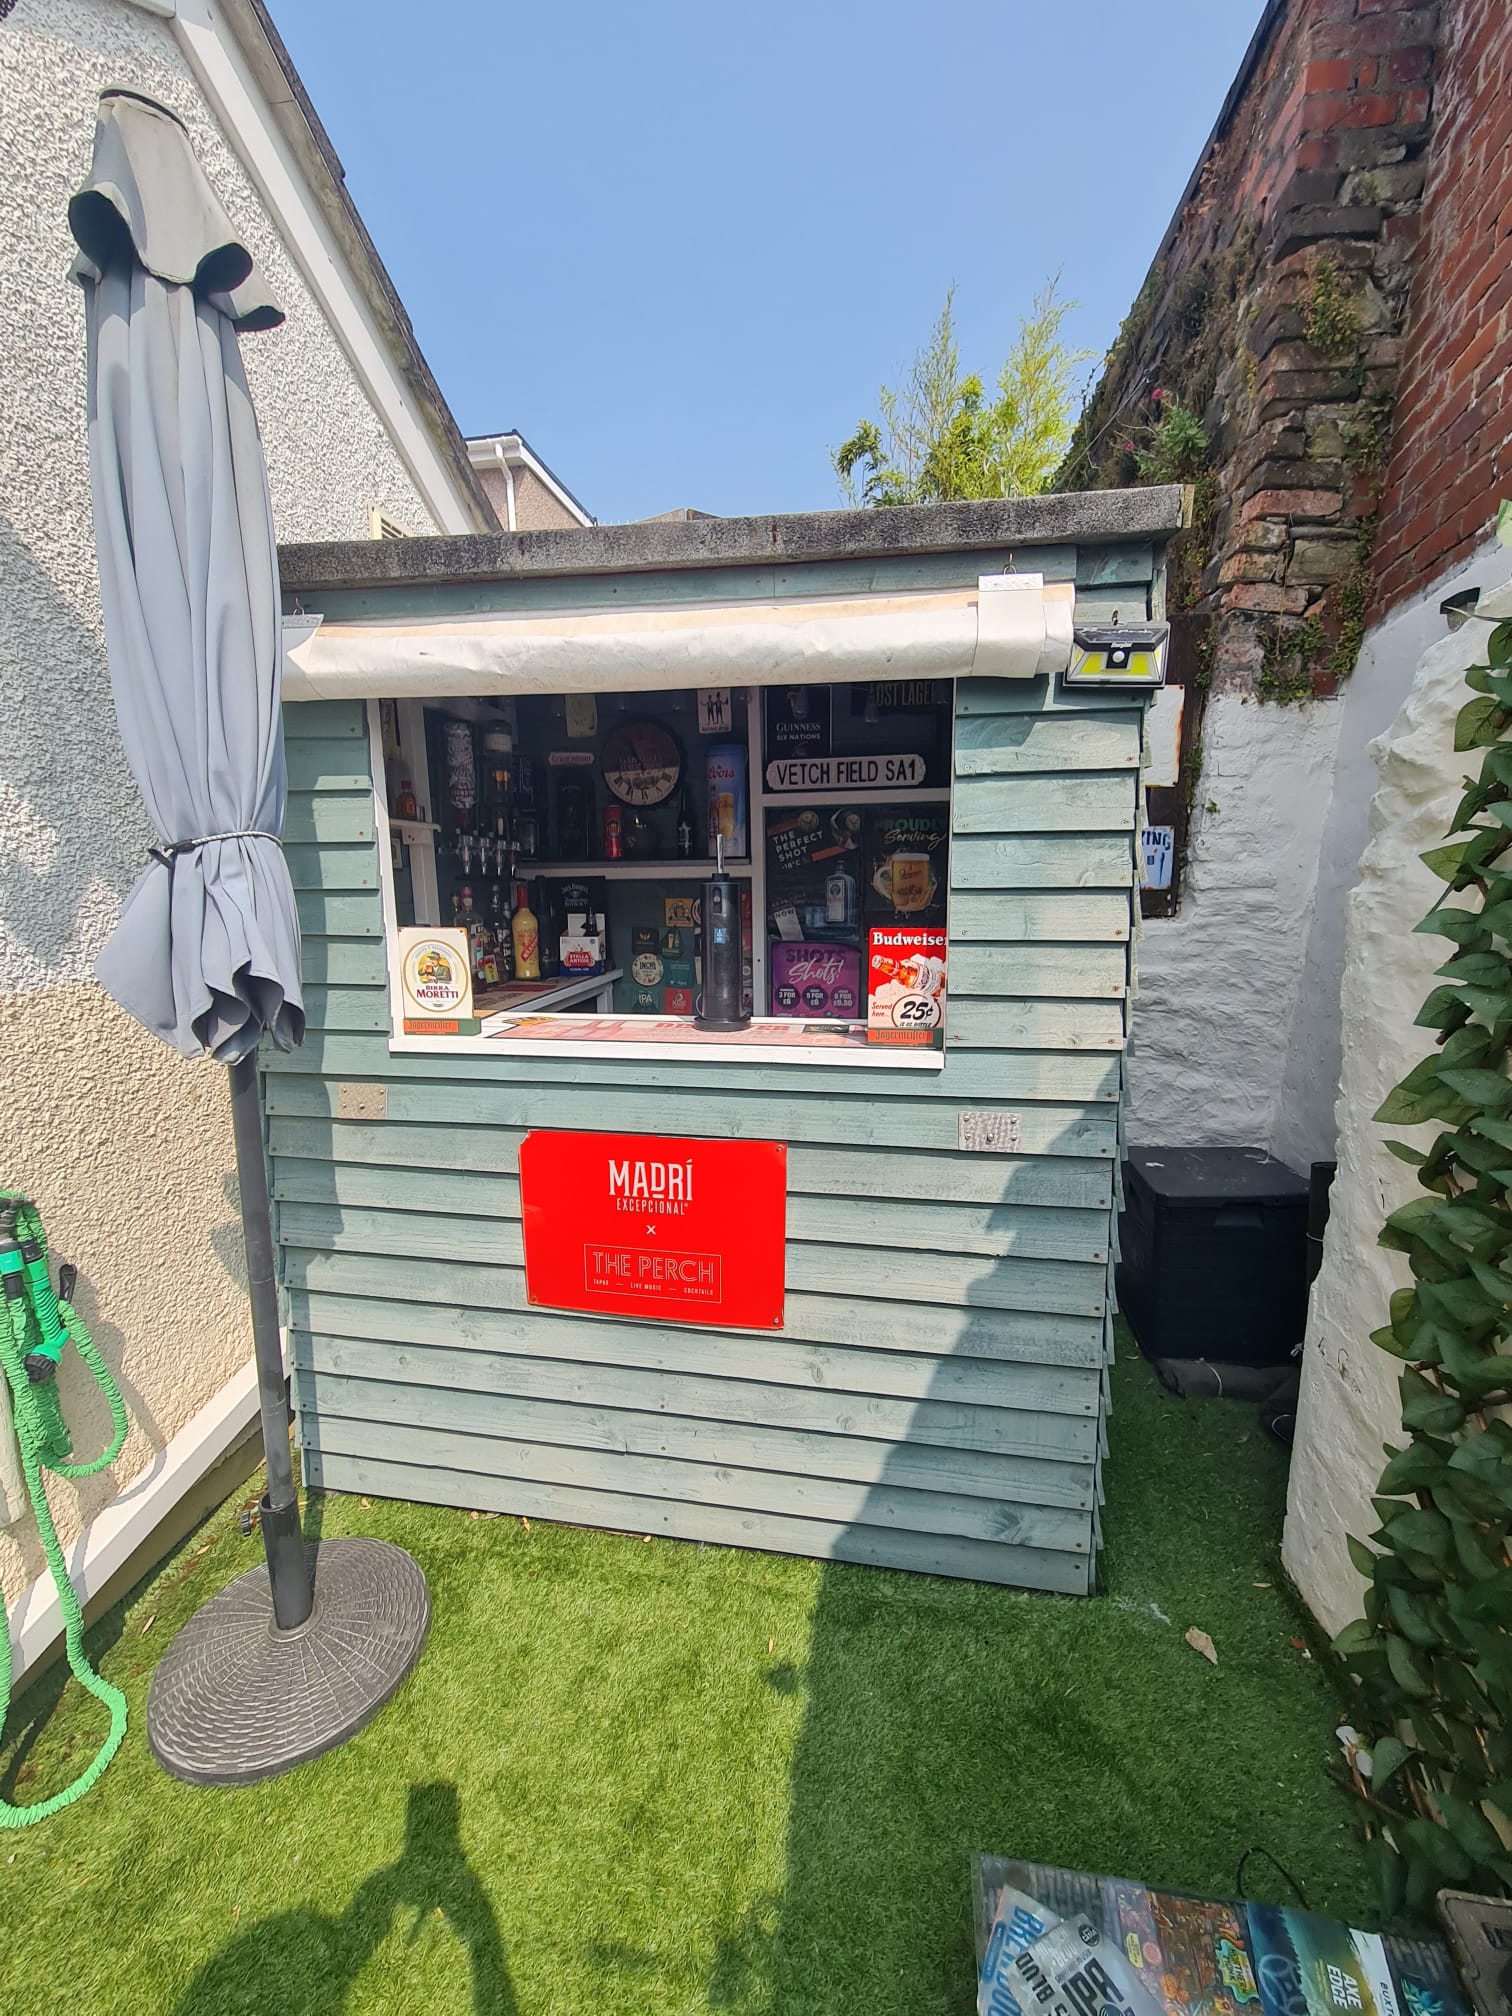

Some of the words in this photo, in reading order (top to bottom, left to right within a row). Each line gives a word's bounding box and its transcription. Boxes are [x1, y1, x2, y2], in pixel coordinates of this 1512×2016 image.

[776, 722, 821, 732] GUINNESS
[789, 733, 821, 741] NATIONS
[708, 768, 735, 779] Coors
[777, 763, 830, 785] VETCH
[837, 760, 878, 784] FIELD
[886, 759, 916, 781] SA1
[773, 831, 796, 844] THE
[776, 831, 824, 853] PERFECT
[885, 829, 946, 851] Serving
[778, 846, 808, 862] SHOT
[785, 949, 846, 964] SHOTS
[789, 957, 845, 985] Shots!
[416, 989, 459, 999] MORETTI
[872, 1002, 893, 1010] Served
[900, 1001, 934, 1020] 25¢
[608, 1158, 693, 1201] MADRÍ
[616, 1197, 688, 1216] EXCEPCIONAL
[592, 1251, 631, 1277] THE
[638, 1256, 714, 1284] PERCH
[683, 1287, 713, 1296] COCKTAILS
[1062, 1957, 1125, 2016] IPA
[1326, 1962, 1349, 2010] EDGE
[1341, 1970, 1364, 2010] AXE
[1379, 1981, 1396, 2016] BUXT
